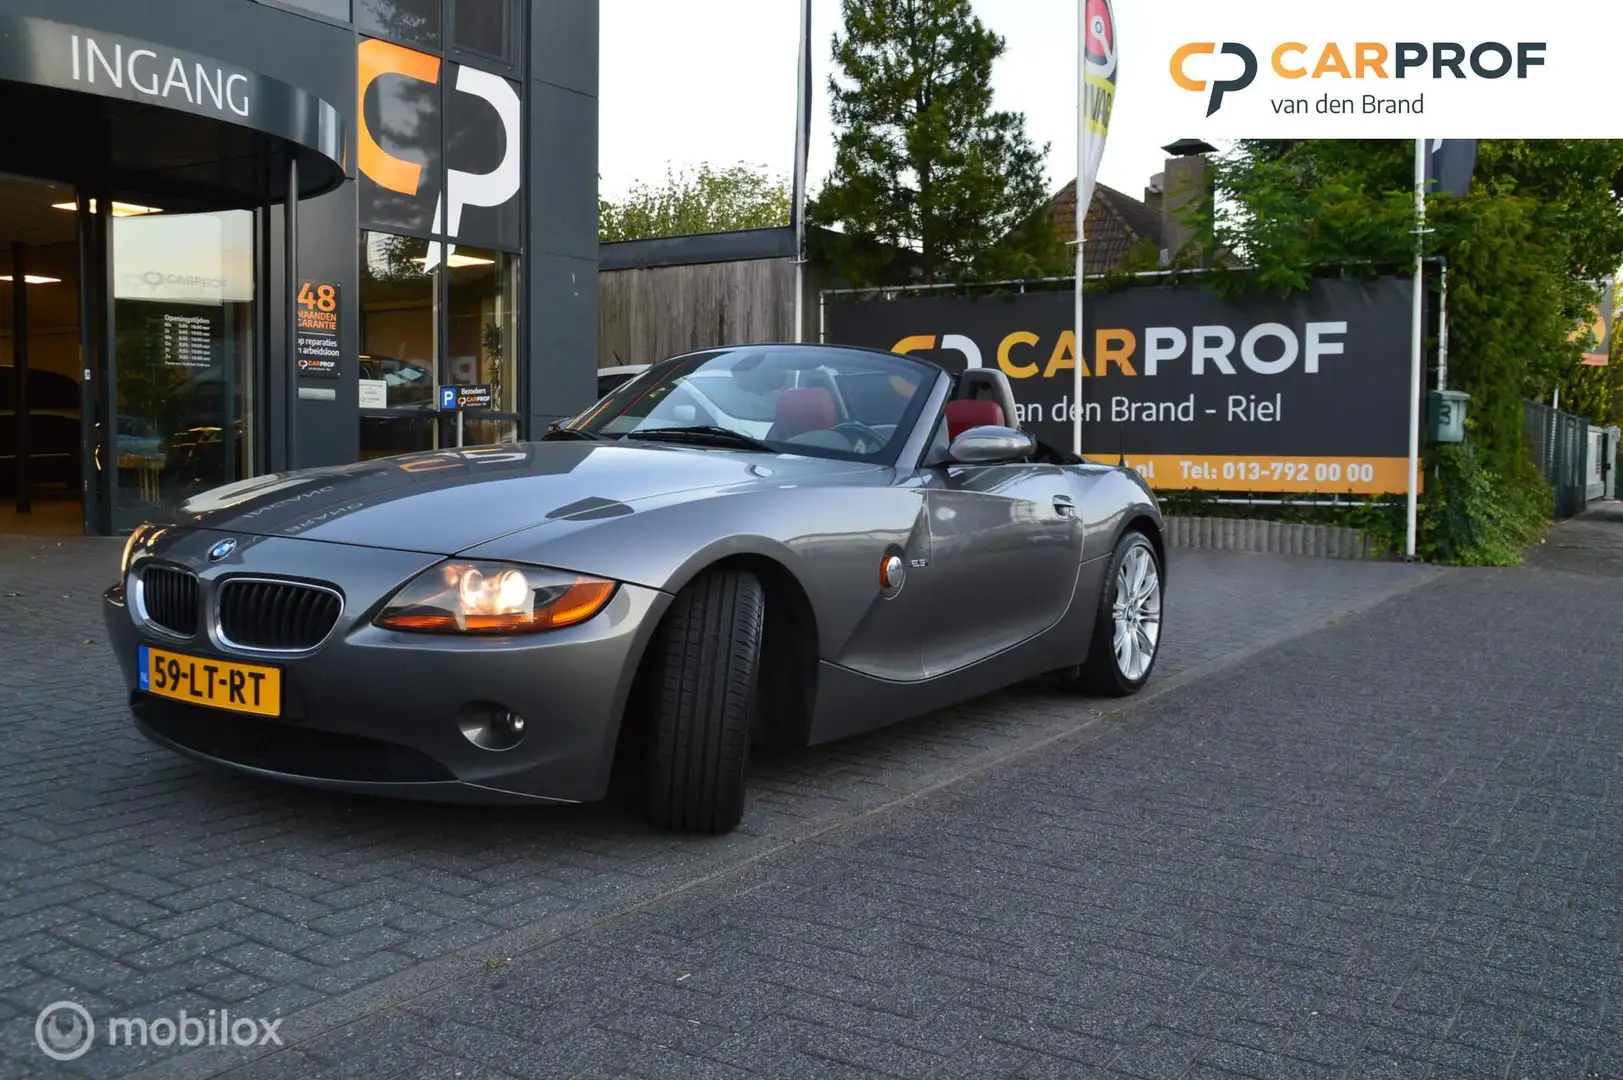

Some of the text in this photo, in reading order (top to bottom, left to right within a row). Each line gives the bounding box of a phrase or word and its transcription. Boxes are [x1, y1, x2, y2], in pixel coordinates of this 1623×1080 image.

[71, 35, 249, 117] INGANG
[297, 282, 336, 312] 48
[997, 321, 1348, 379] CARPROF
[1015, 402, 1043, 422] an
[1111, 393, 1195, 423] Brand
[1228, 393, 1281, 422] Riel
[1180, 460, 1217, 480] Tel:
[1222, 461, 1309, 482] 013-792
[1315, 463, 1341, 482] 00
[1347, 463, 1374, 482] 00
[155, 656, 266, 707] 59-LT-RT
